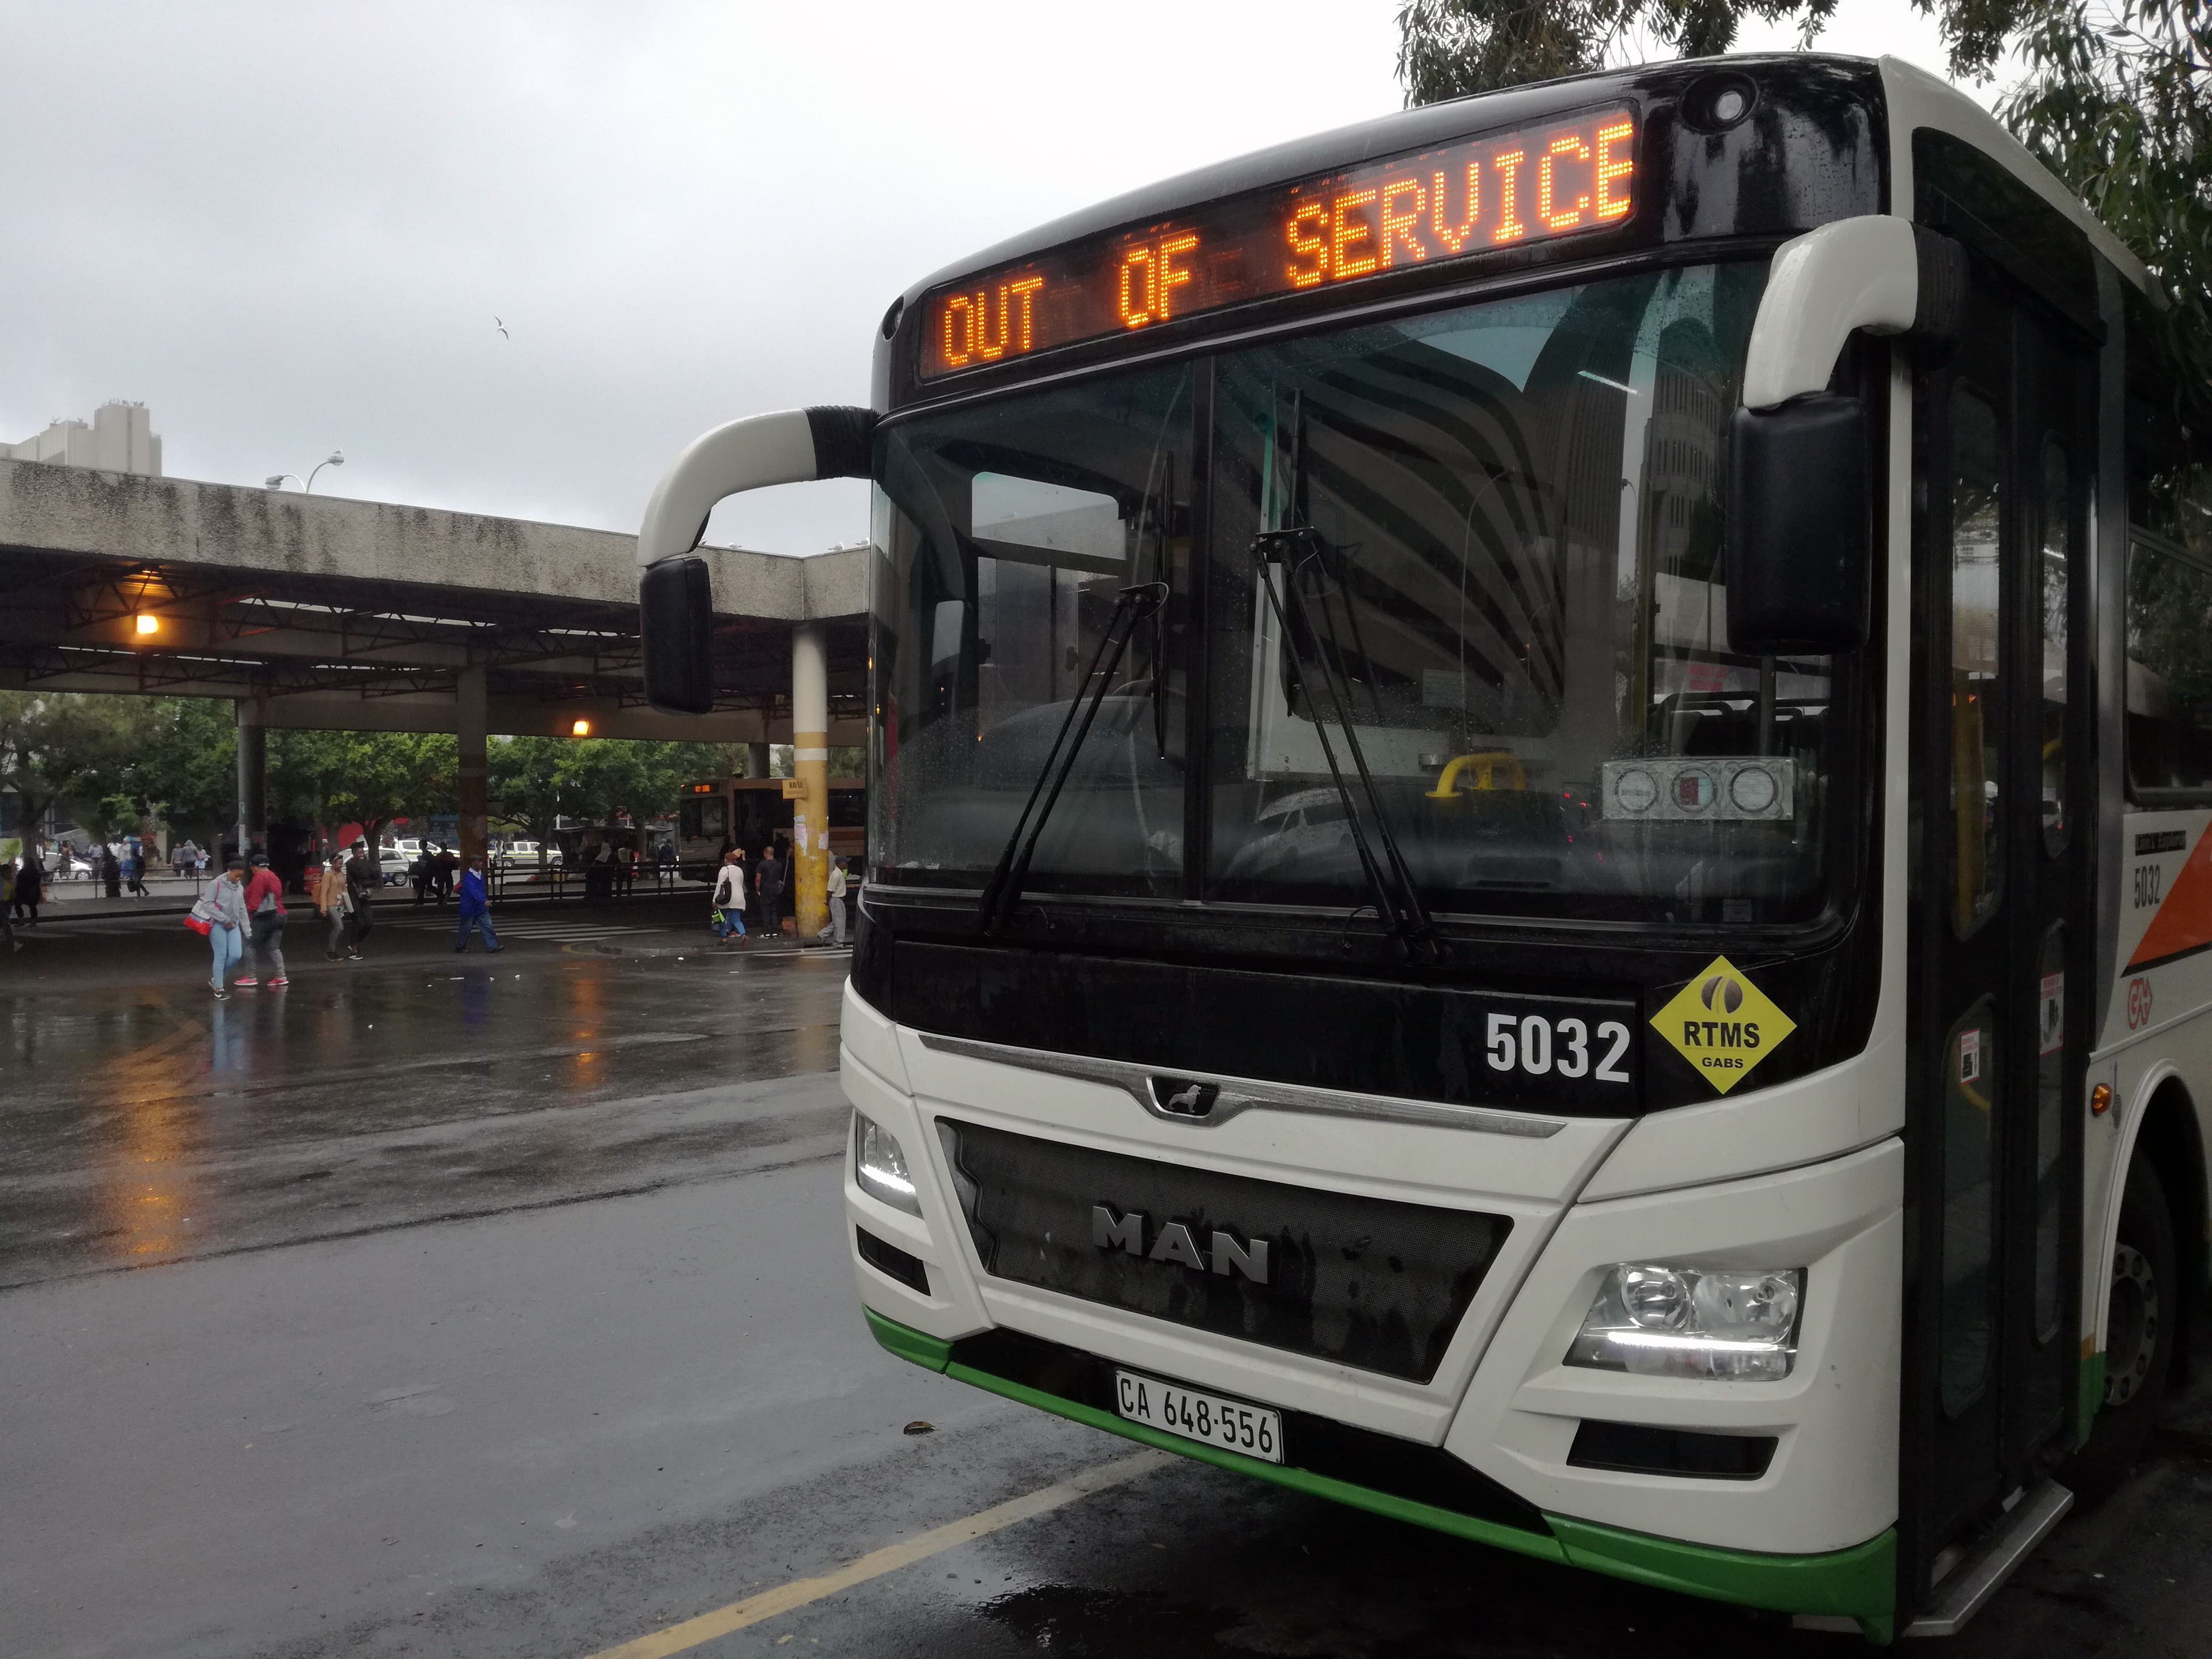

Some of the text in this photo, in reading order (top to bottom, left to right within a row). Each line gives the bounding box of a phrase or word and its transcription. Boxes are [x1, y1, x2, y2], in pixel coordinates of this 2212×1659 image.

[943, 120, 1634, 366] OUT OF SERVICE
[2135, 865, 2160, 909] 5032
[1487, 1013, 1631, 1083] 5032
[1683, 1021, 1760, 1049] RTMS
[1702, 1056, 1744, 1069] GABS
[1092, 1205, 1269, 1285] MAN
[1120, 1377, 1151, 1419] CA
